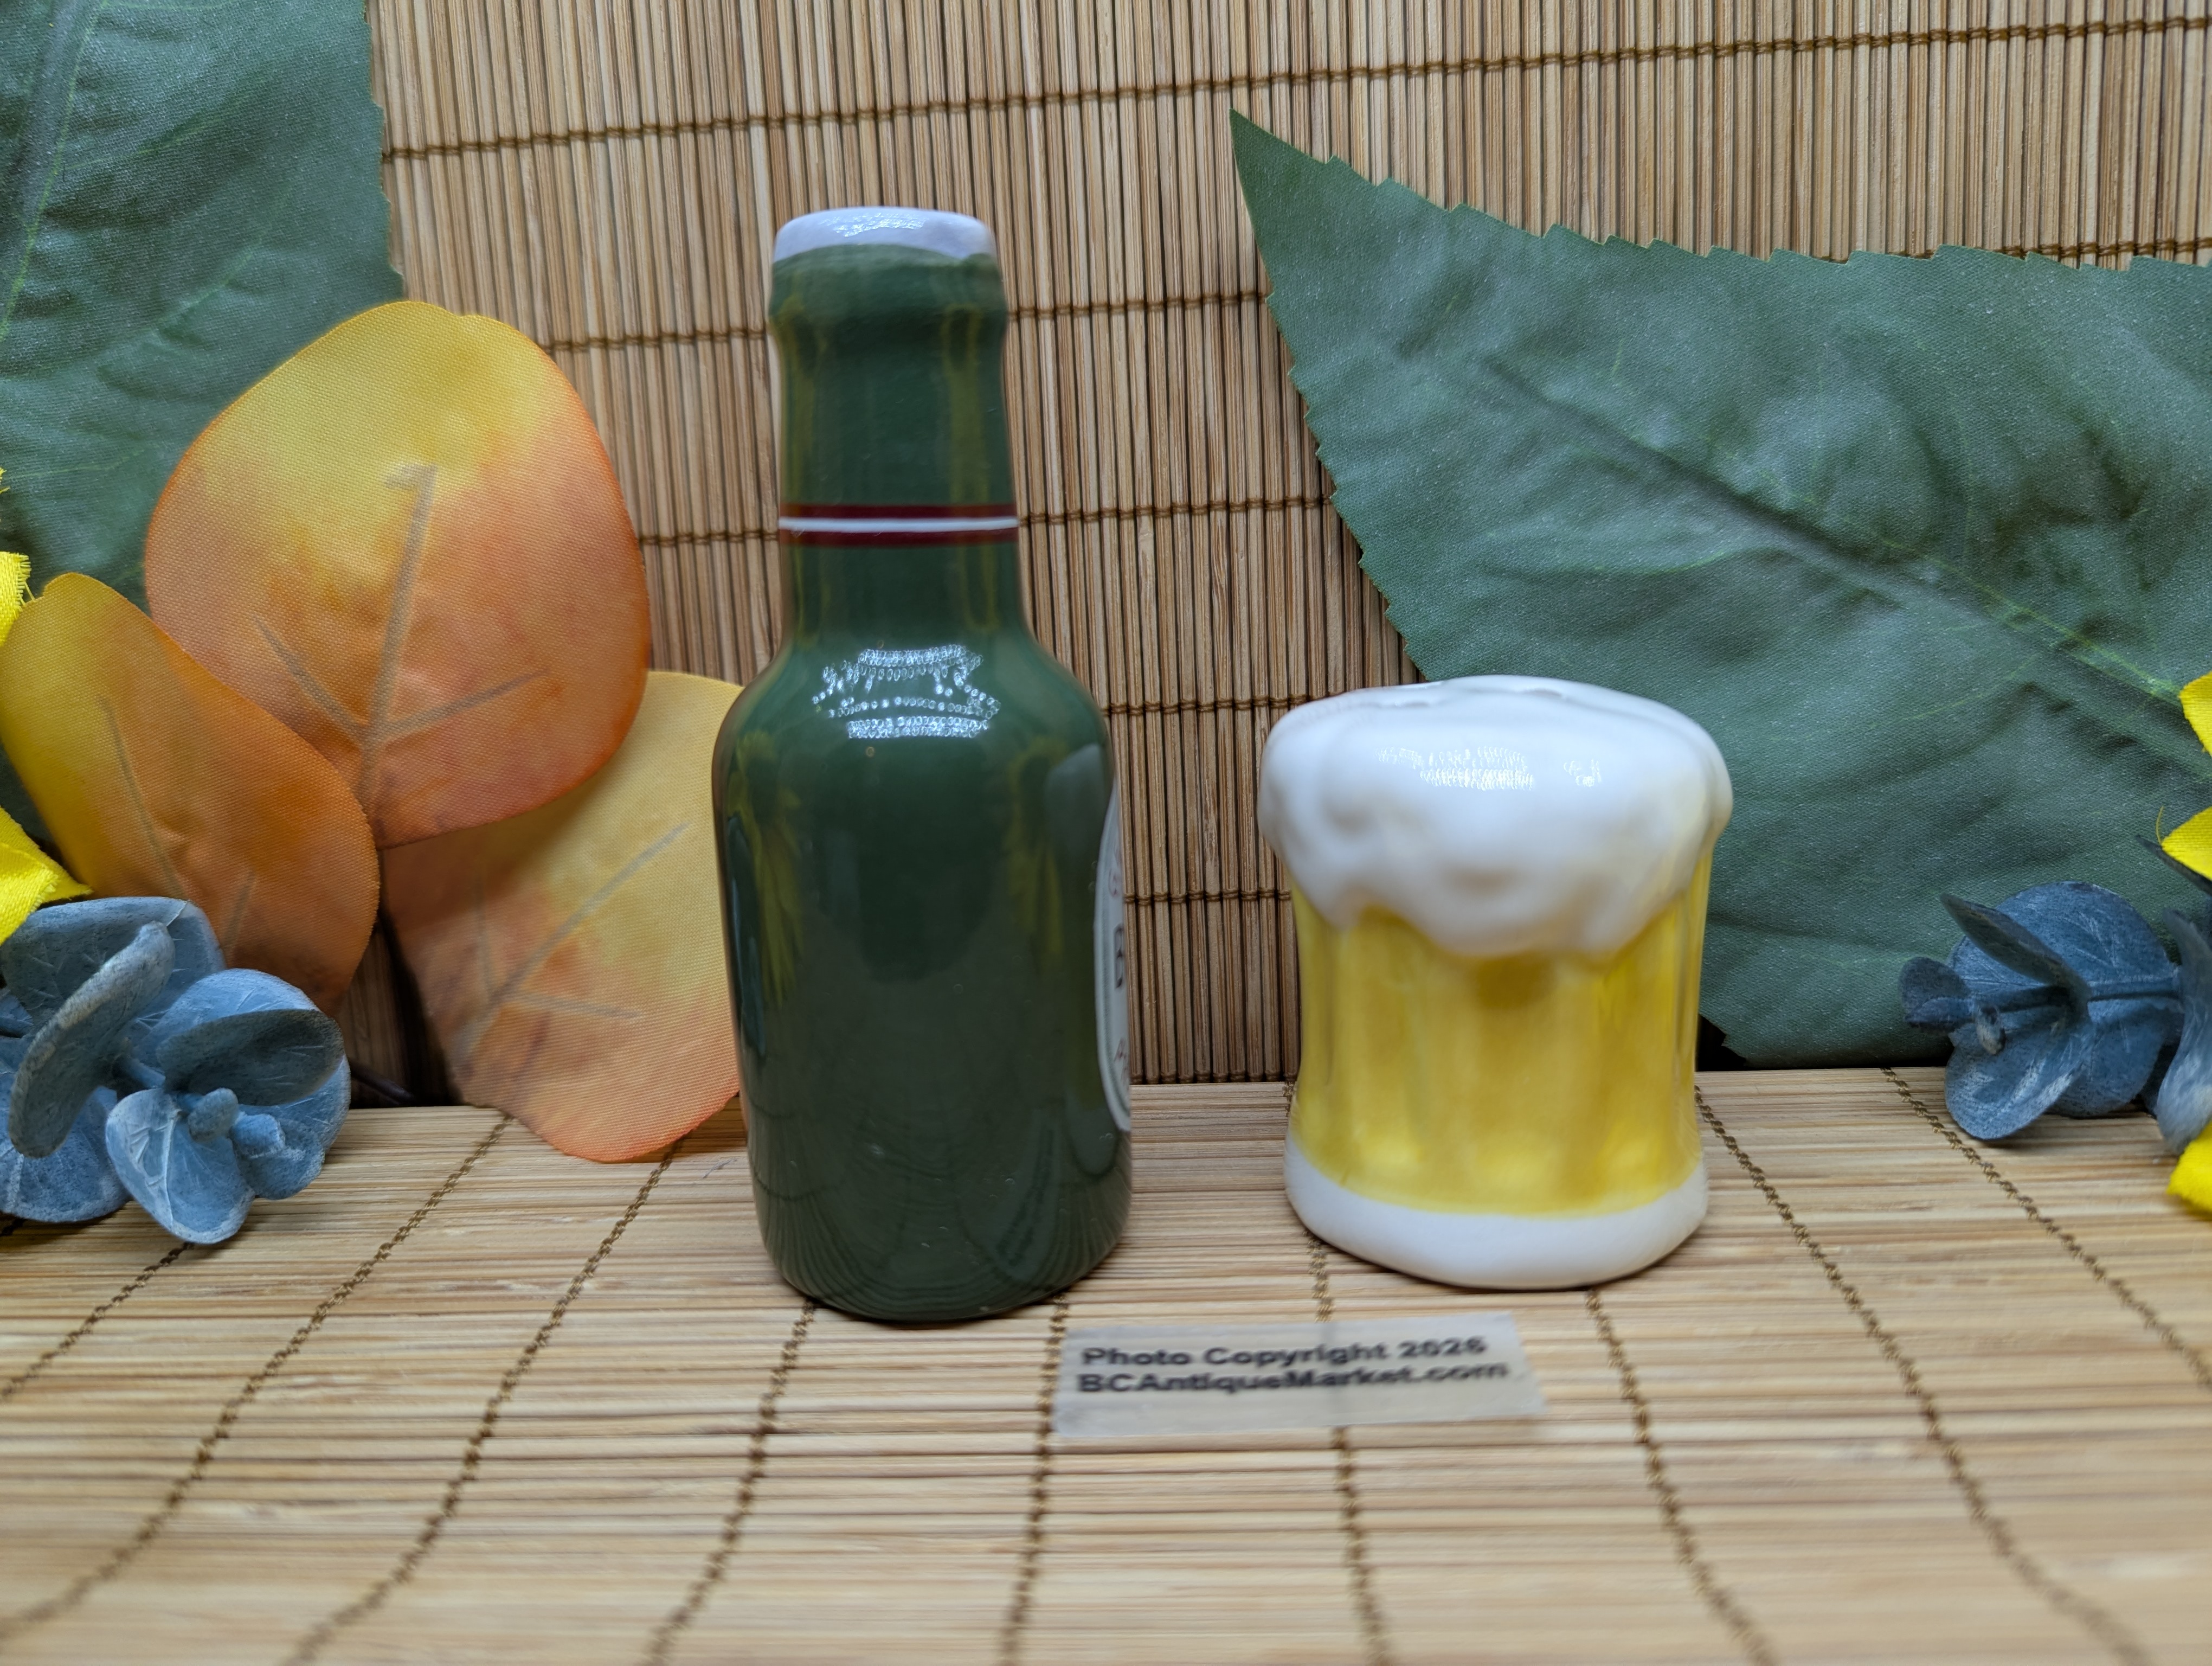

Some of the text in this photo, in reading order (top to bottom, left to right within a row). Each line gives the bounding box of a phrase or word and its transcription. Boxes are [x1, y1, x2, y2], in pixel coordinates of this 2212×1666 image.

[1083, 1347, 1191, 1364] Photo
[1204, 1342, 1388, 1367] Copyright
[1078, 1363, 1509, 1393] BCAntiqueMarket.com
